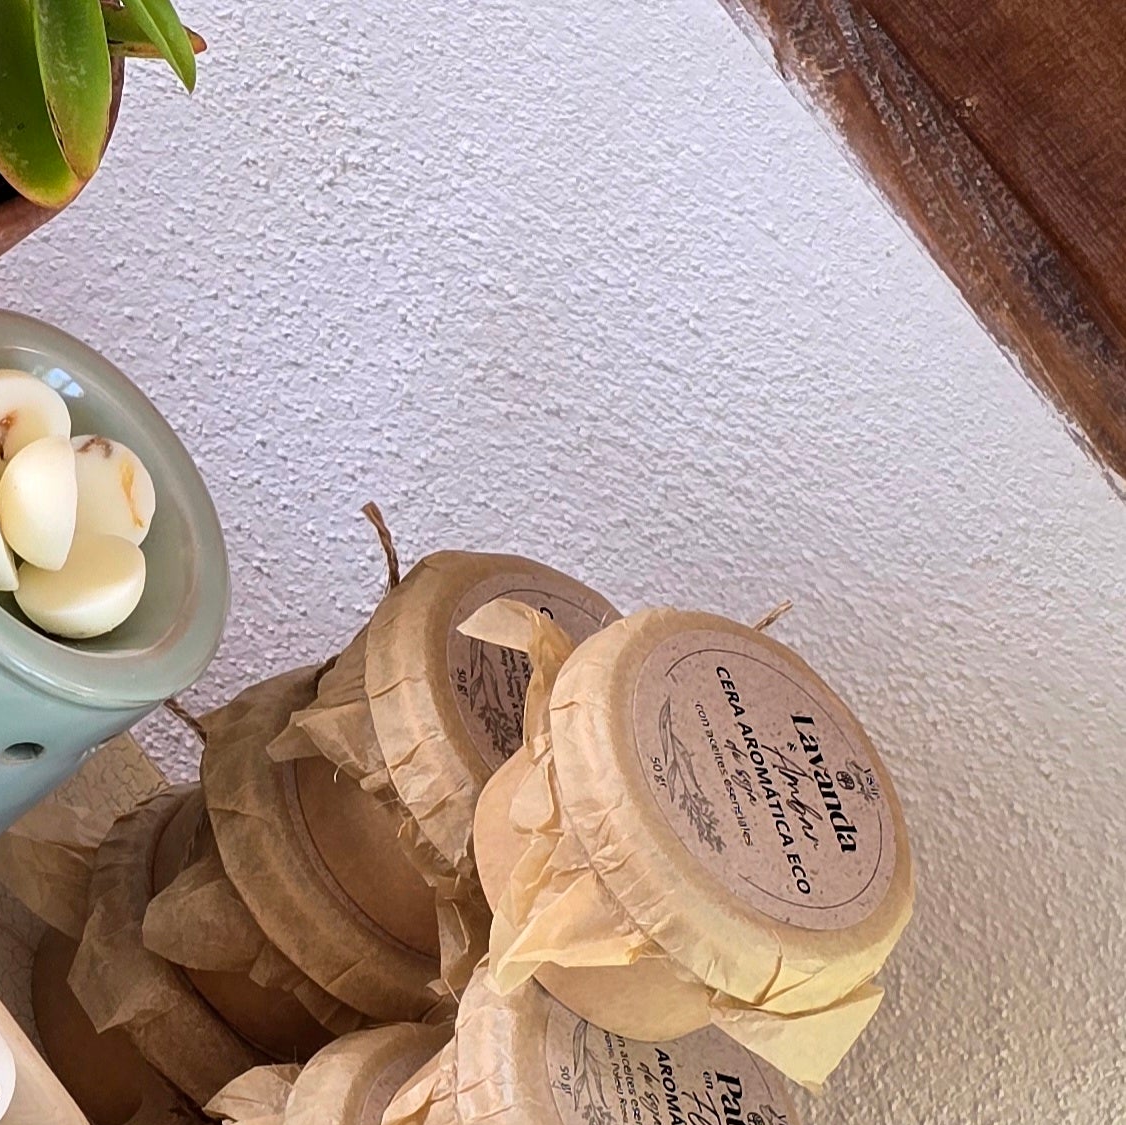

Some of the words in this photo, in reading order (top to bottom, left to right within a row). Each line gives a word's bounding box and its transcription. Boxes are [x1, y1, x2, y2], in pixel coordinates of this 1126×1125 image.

[649, 756, 664, 772] 50
[715, 666, 746, 718] CERA
[736, 721, 795, 848] AROMÁTICA
[786, 853, 811, 895] ECO
[789, 711, 858, 853] Lavanda
[702, 1070, 714, 1090] en
